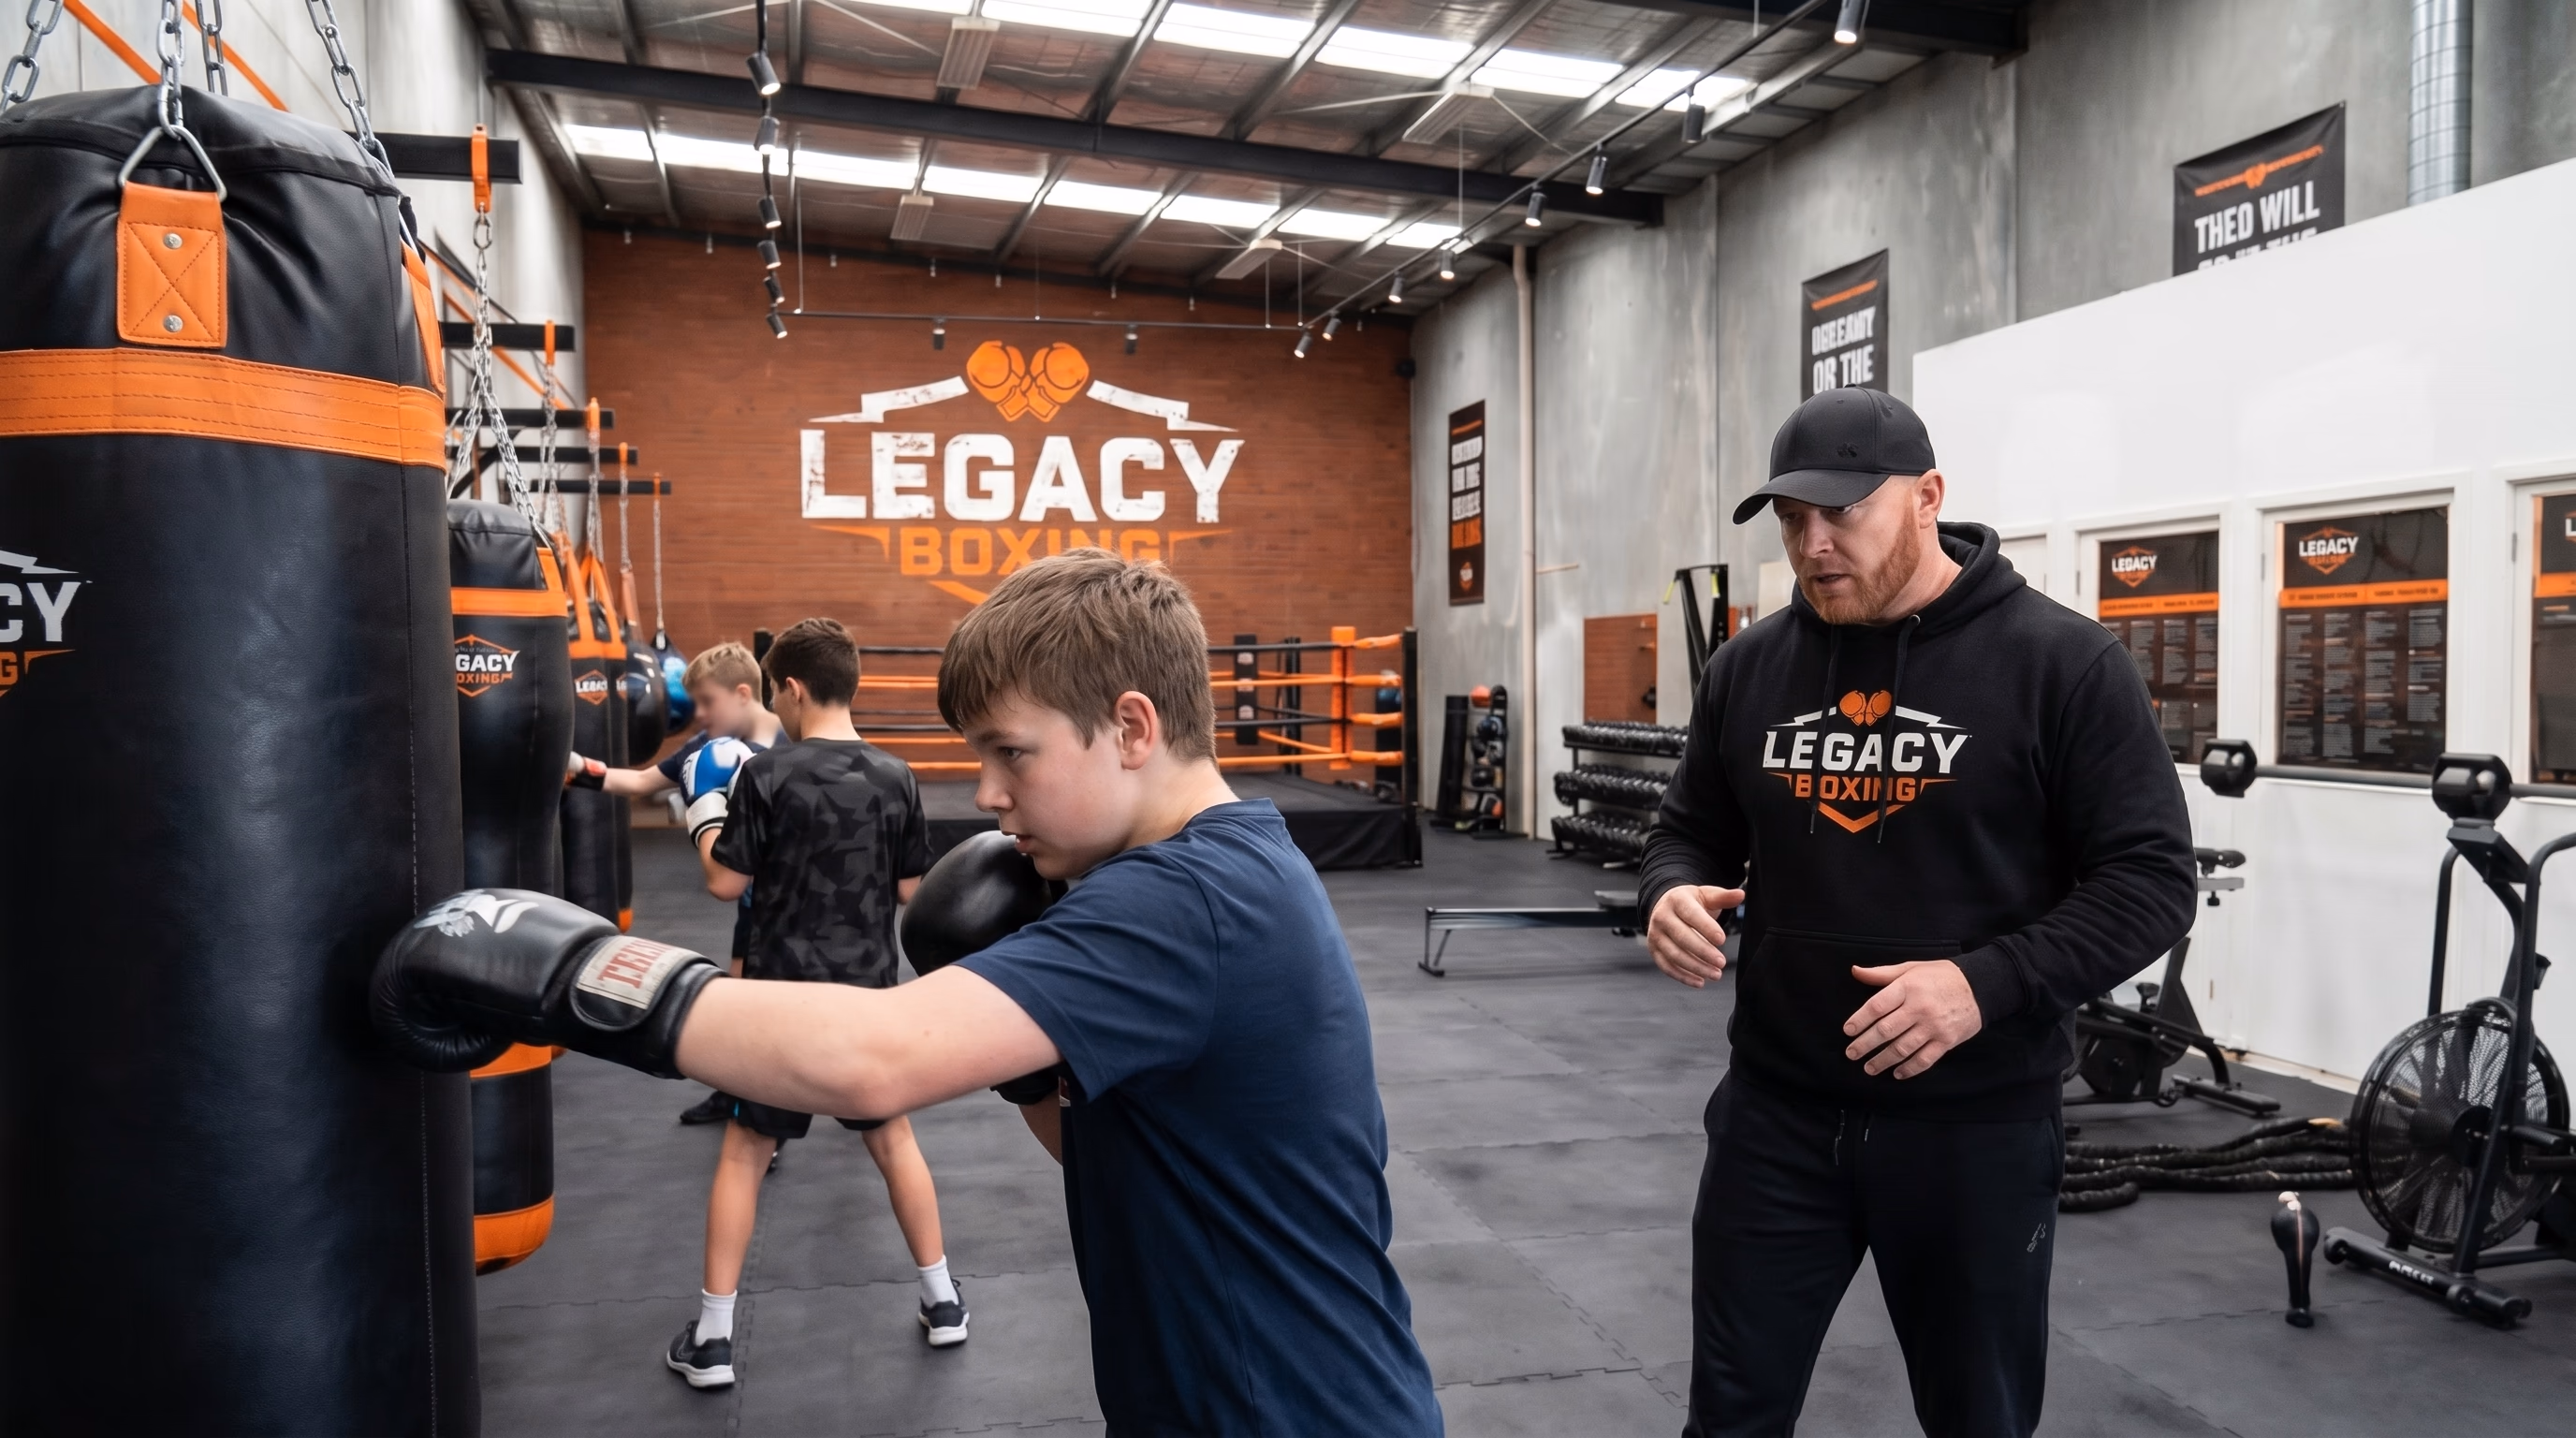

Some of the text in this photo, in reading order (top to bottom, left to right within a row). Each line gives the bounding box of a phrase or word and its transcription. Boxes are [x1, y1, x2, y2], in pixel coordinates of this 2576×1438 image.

[2260, 180, 2320, 234] WILL
[1813, 344, 1874, 395] OR THE
[800, 429, 1245, 523] LEGACY
[2298, 536, 2359, 557] LEGACY
[2112, 554, 2158, 573] LEGACY
[455, 650, 520, 672] GACY
[457, 672, 500, 684] OXING
[1763, 731, 1969, 774] LEGACY
[1795, 774, 1916, 802] BOXING
